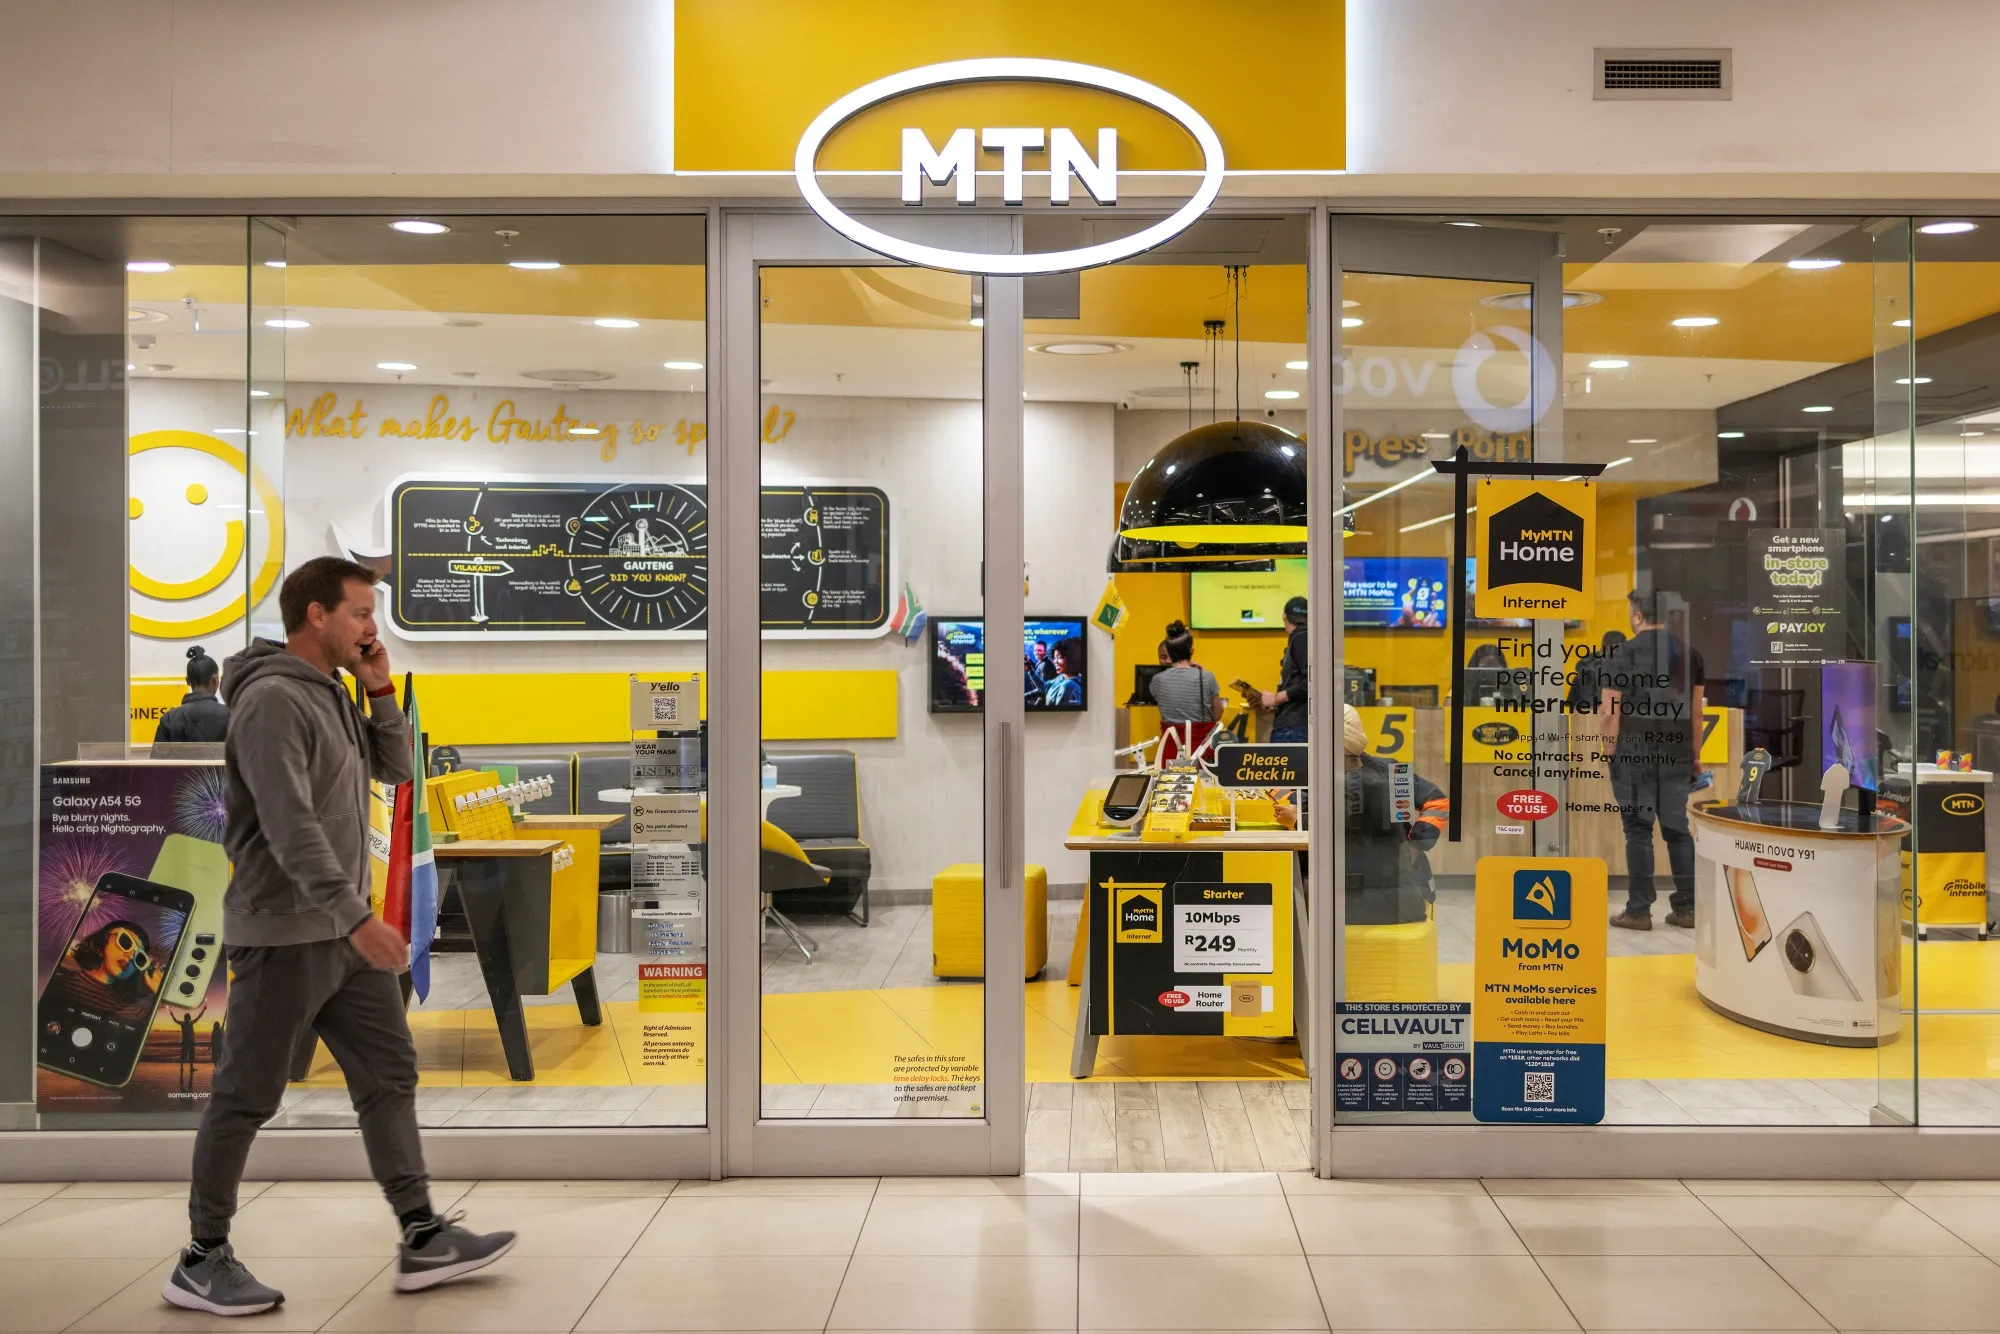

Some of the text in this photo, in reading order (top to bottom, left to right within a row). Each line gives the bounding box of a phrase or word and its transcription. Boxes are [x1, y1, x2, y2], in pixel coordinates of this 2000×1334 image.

[901, 128, 1117, 205] MTN
[285, 393, 367, 440] What
[379, 394, 478, 442] makes
[487, 400, 619, 462] Gauteng
[630, 411, 667, 444] so
[1521, 529, 1573, 543] MyMTN
[1773, 536, 1789, 544] Get
[1500, 541, 1574, 562] Home
[1768, 545, 1824, 553] smartphone
[623, 561, 674, 570] GAUTENG
[1764, 554, 1828, 570] in-store
[454, 564, 492, 572] VILAKAZI
[610, 573, 686, 582] DID YOU KNOW?
[1770, 570, 1822, 588] today!
[1503, 596, 1567, 609] Internet
[1779, 622, 1826, 633] PAYJOY
[1498, 638, 1619, 663] Find your
[1496, 666, 1670, 690] perfect home
[1351, 680, 1358, 691] 5
[1496, 694, 1684, 721] internet today
[1376, 713, 1408, 754] 5
[1644, 731, 1684, 744] R249
[1242, 753, 1288, 766] Please
[1494, 750, 1513, 761] No
[1591, 752, 1616, 765] Pay
[1620, 753, 1680, 766] monthly.
[1236, 767, 1296, 781] Check in
[1494, 766, 1604, 780] Cancel anytime.
[1749, 767, 1758, 782] 9
[53, 796, 142, 808] Galaxy A54 5G
[1513, 795, 1542, 804] FREE
[1952, 800, 1975, 809] MTN
[1507, 805, 1547, 814] TO USE
[1565, 802, 1644, 813] Home Router
[52, 813, 130, 824] Bye blurry nights.
[52, 824, 166, 835] Hello crisp Nightography.
[1735, 839, 1815, 860] HUAWEI nova Y91
[1203, 890, 1244, 899] Starter
[1125, 913, 1154, 922] Home
[1185, 912, 1240, 926] 10Mbps
[1185, 935, 1236, 952] R249
[1503, 938, 1579, 959] MoMo
[644, 967, 702, 977] WARNING
[1543, 963, 1564, 971] MTN
[1485, 984, 1597, 994] MTN MoMo services
[1197, 991, 1222, 999] Home
[1506, 996, 1575, 1004] available here
[1195, 1000, 1224, 1008] Router
[1341, 1018, 1464, 1035] CELLVAULT
[906, 1065, 939, 1073] protected
[941, 1065, 949, 1073] by
[910, 1075, 929, 1083] delay
[916, 1084, 934, 1092] safes
[961, 1084, 976, 1092] kept
[904, 1094, 916, 1102] the
[917, 1095, 949, 1103] premises.
